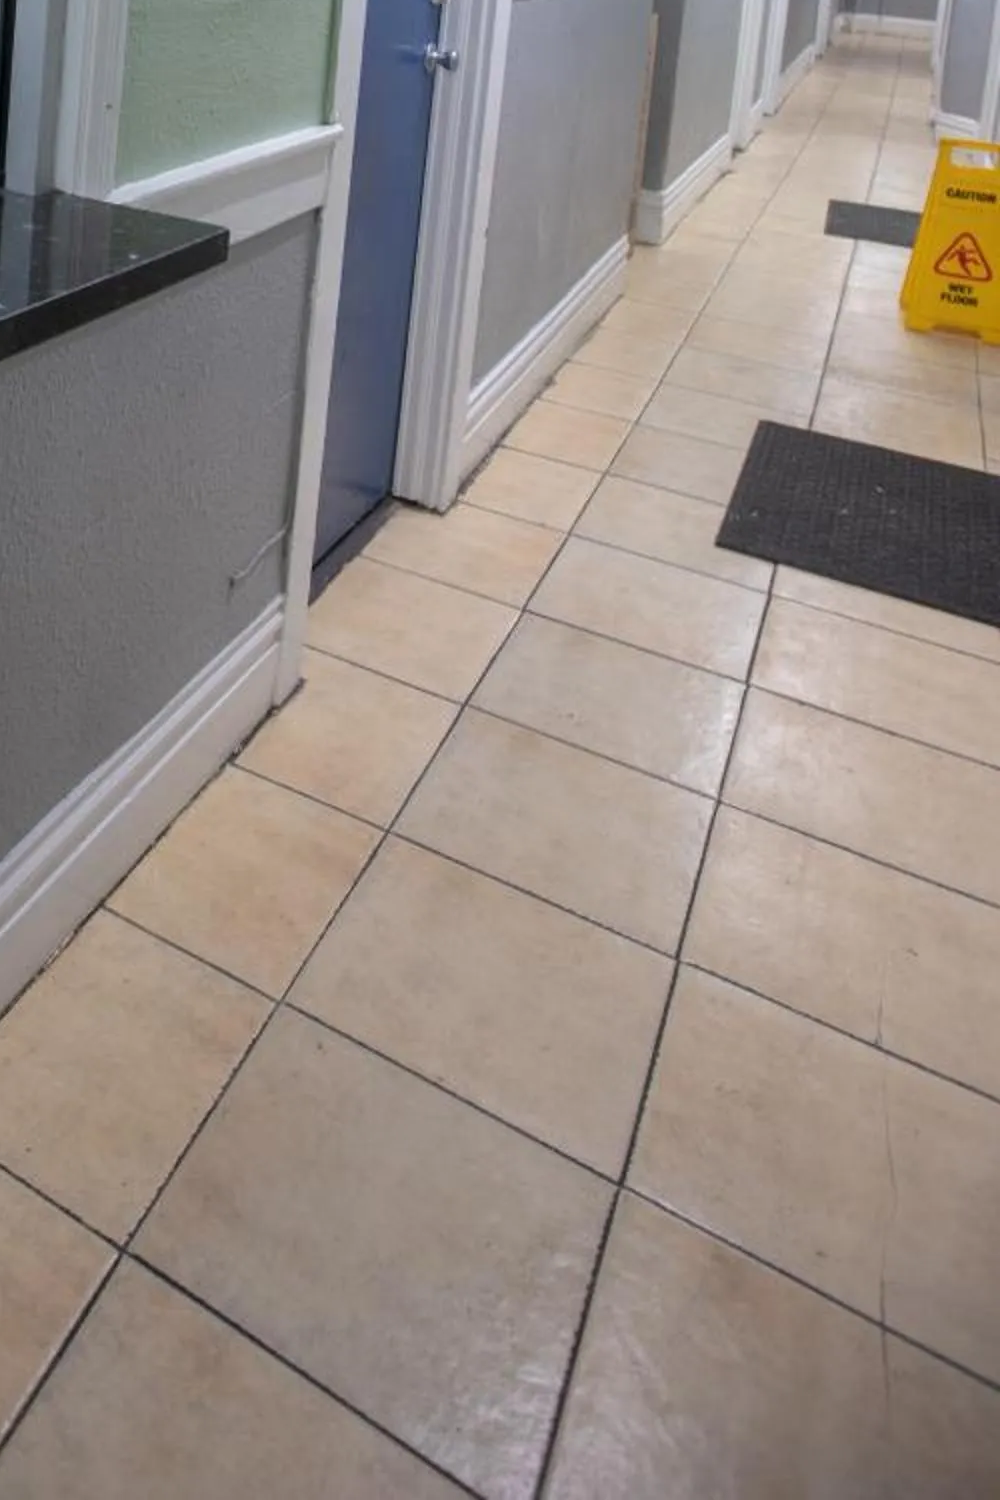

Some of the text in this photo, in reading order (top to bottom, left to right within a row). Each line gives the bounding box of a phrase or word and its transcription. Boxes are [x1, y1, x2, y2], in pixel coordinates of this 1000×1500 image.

[946, 186, 996, 204] CAUTION
[948, 283, 974, 295] WET
[940, 292, 978, 307] FLOOR
